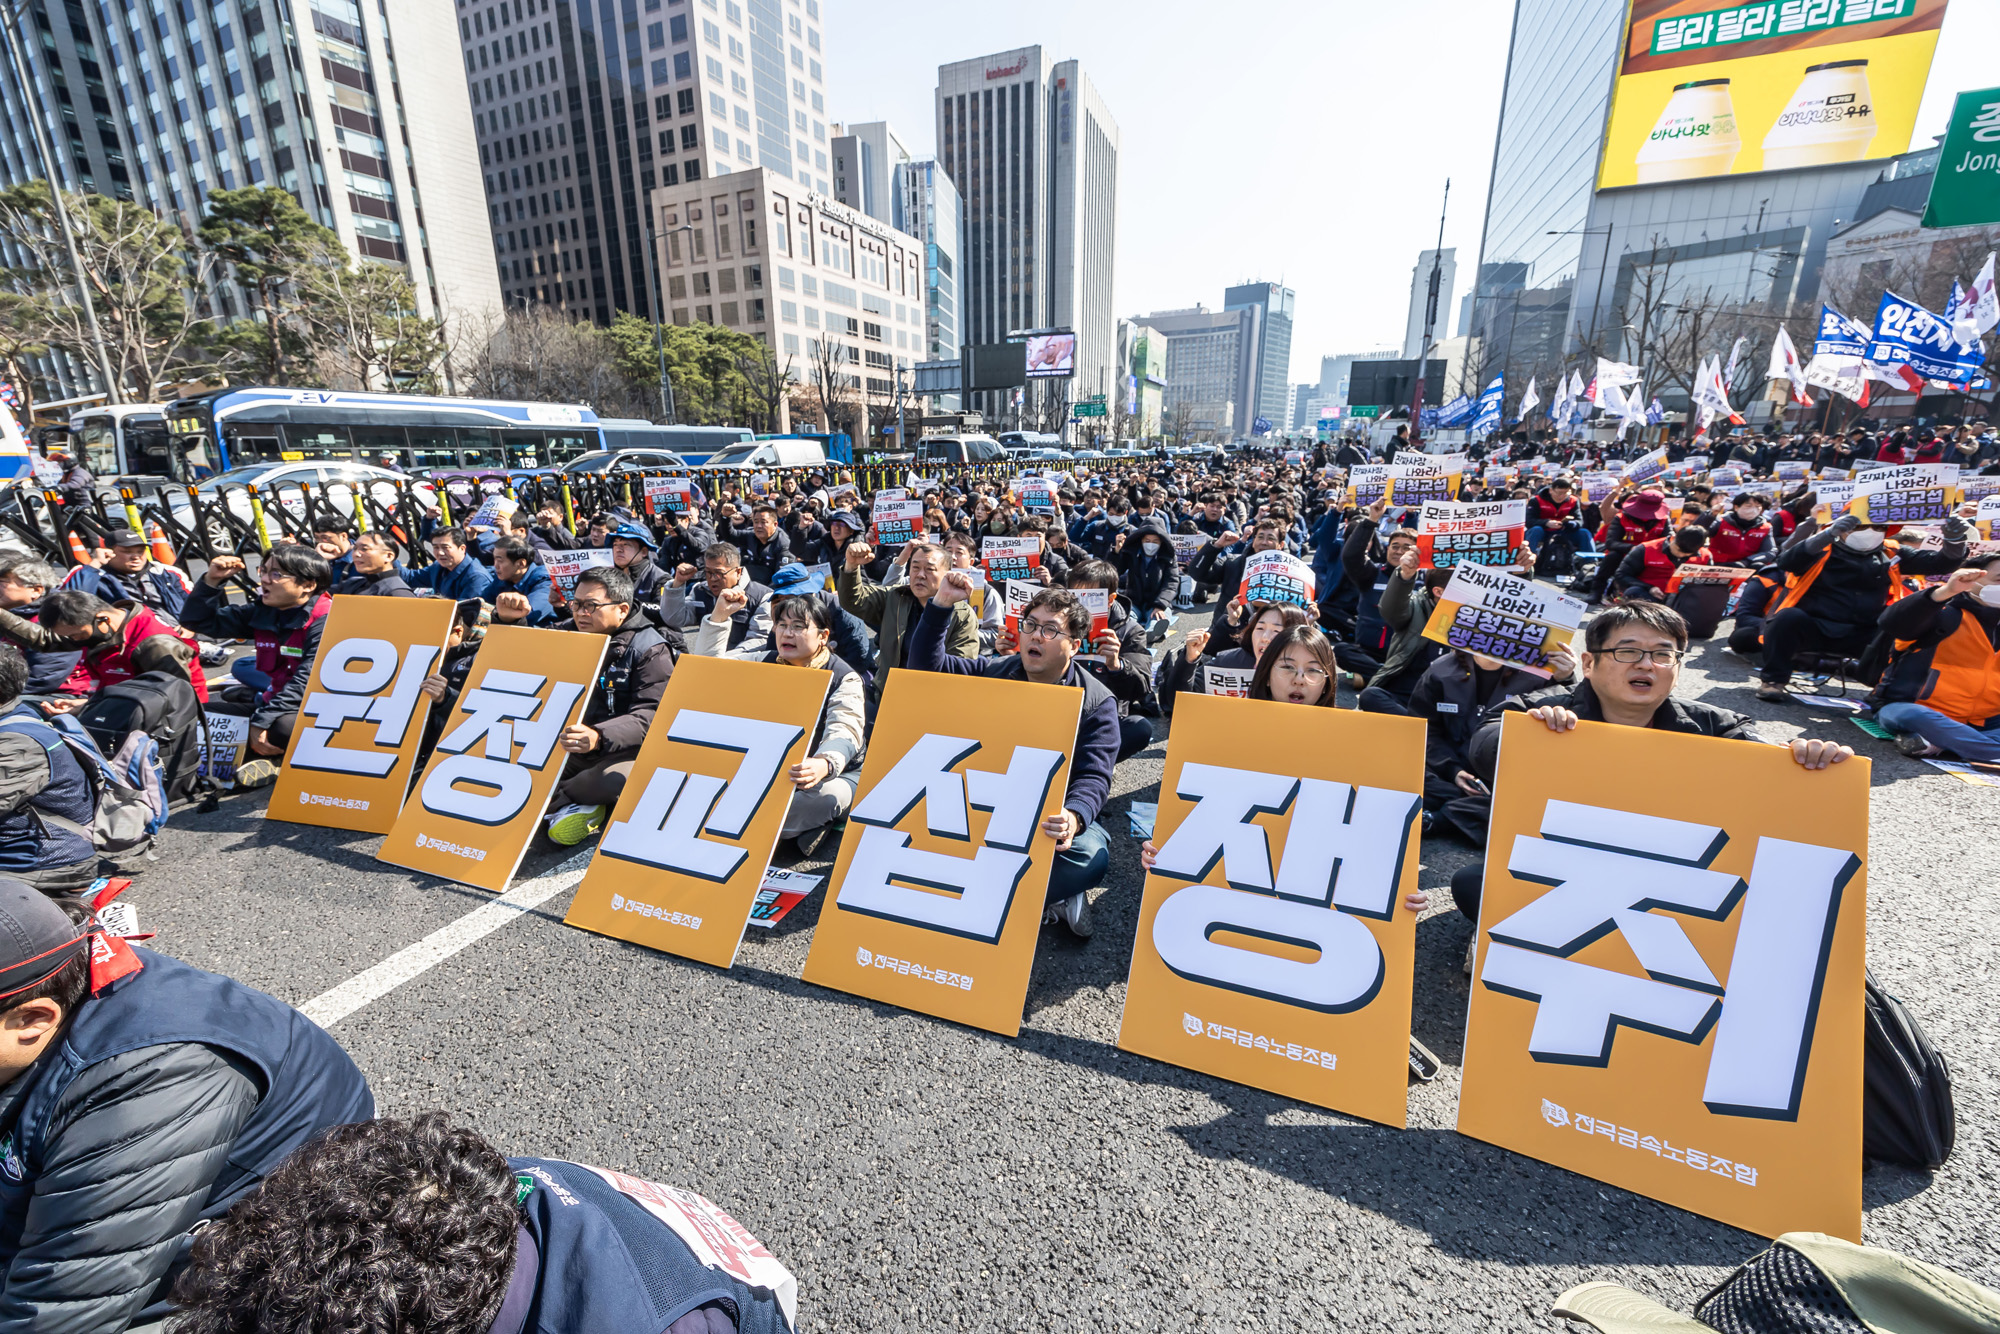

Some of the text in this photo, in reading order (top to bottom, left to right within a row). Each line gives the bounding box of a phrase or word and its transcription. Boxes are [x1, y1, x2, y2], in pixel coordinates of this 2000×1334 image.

[1656, 16, 1714, 52] 달라
[1715, 6, 1776, 43] 달라
[1777, 0, 1841, 33] 달라
[986, 65, 1021, 80] kobaco
[1779, 107, 1843, 126] 바나나맛
[1651, 124, 1710, 141] 바나나맛
[300, 392, 333, 404] EV
[519, 457, 538, 469] 150
[1394, 455, 1427, 466] 진짜사장
[1405, 466, 1442, 477] 나와라!
[1860, 466, 1917, 484] 진짜사장
[1393, 477, 1448, 492] 원청교섭
[1885, 474, 1938, 491] 나와라!
[652, 492, 682, 503] 투쟁으로
[1867, 488, 1944, 508] 원청교섭
[884, 502, 906, 511] 노동자의
[1425, 504, 1503, 520] 모든 노동자의
[1867, 503, 1951, 523] 쟁취하자!
[877, 519, 912, 532] 투쟁으로
[1426, 519, 1487, 533] 노동기본권
[878, 531, 919, 544] 쟁취하자!
[984, 539, 1022, 548] 모든 노동자의
[1433, 531, 1509, 550] 투쟁으로
[555, 552, 590, 564] 노동자의
[984, 548, 1014, 557] 노동기본권
[1432, 548, 1518, 568] 쟁취하자!
[988, 557, 1029, 569] 투쟁으로
[1246, 563, 1289, 577] 노동기본권
[1247, 554, 1300, 569] 모든 노동자의
[990, 568, 1036, 581] 쟁취하자!
[1248, 573, 1304, 593] 투쟁으로
[1457, 565, 1527, 597] 진짜사장
[1009, 586, 1029, 602] 모든
[1246, 586, 1312, 609] 쟁취하자!
[1482, 592, 1546, 619] 나와라!
[1455, 604, 1548, 646] 원청교섭
[1448, 625, 1550, 667] 쟁취하자!
[1209, 672, 1238, 687] 모든
[290, 637, 441, 778] 원
[436, 668, 586, 827] 청
[310, 794, 370, 811] 전국금속노동조합
[600, 708, 805, 884] 교
[836, 733, 1066, 945] 섭
[426, 837, 487, 861] 전국금속노동조합
[1149, 762, 1423, 1014] 쟁
[624, 899, 702, 930] 전국금속노동조합
[1481, 799, 1863, 1122] 취
[874, 953, 973, 991] 전국금속노동조합
[1206, 1021, 1338, 1071] 전국금속노동조합
[1574, 1112, 1758, 1187] 전국금속노동조합
